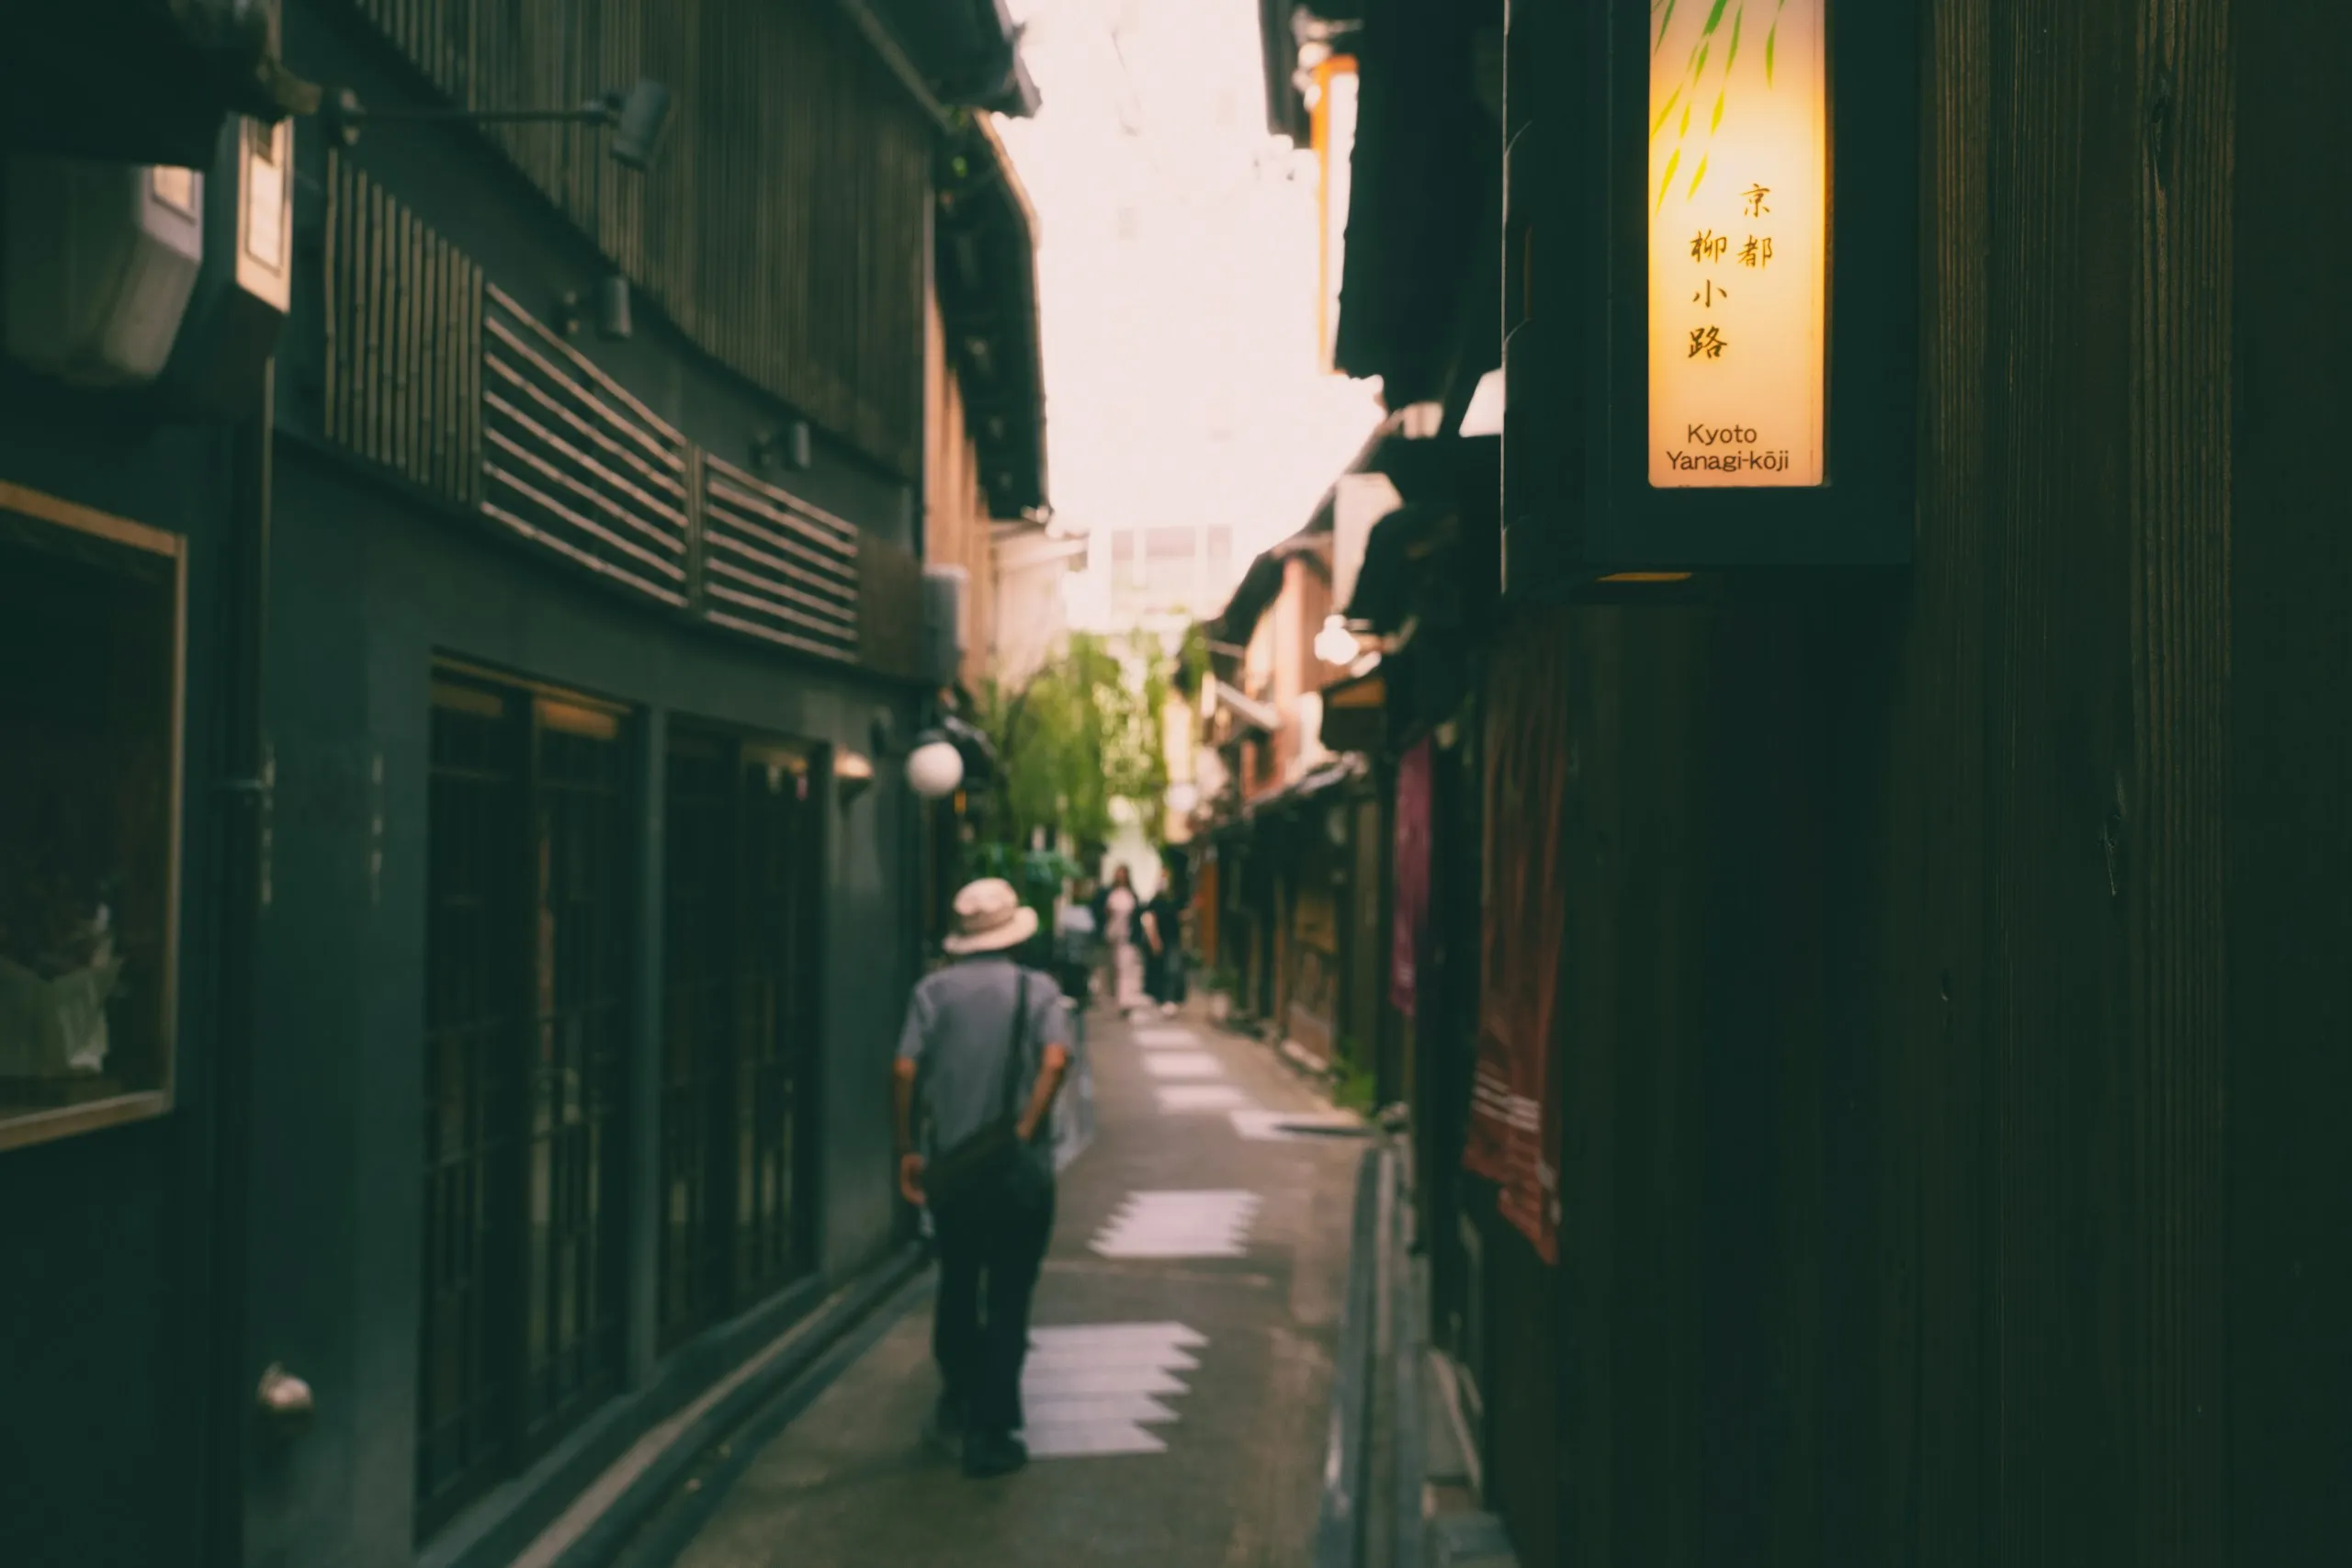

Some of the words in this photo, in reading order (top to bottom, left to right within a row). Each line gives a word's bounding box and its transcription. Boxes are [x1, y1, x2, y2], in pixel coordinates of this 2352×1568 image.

[1737, 184, 1773, 267] 京都
[1688, 230, 1728, 359] 柳小路
[1666, 450, 1789, 472] Yanagi-kōji
[1687, 423, 1758, 446] Kyoto
